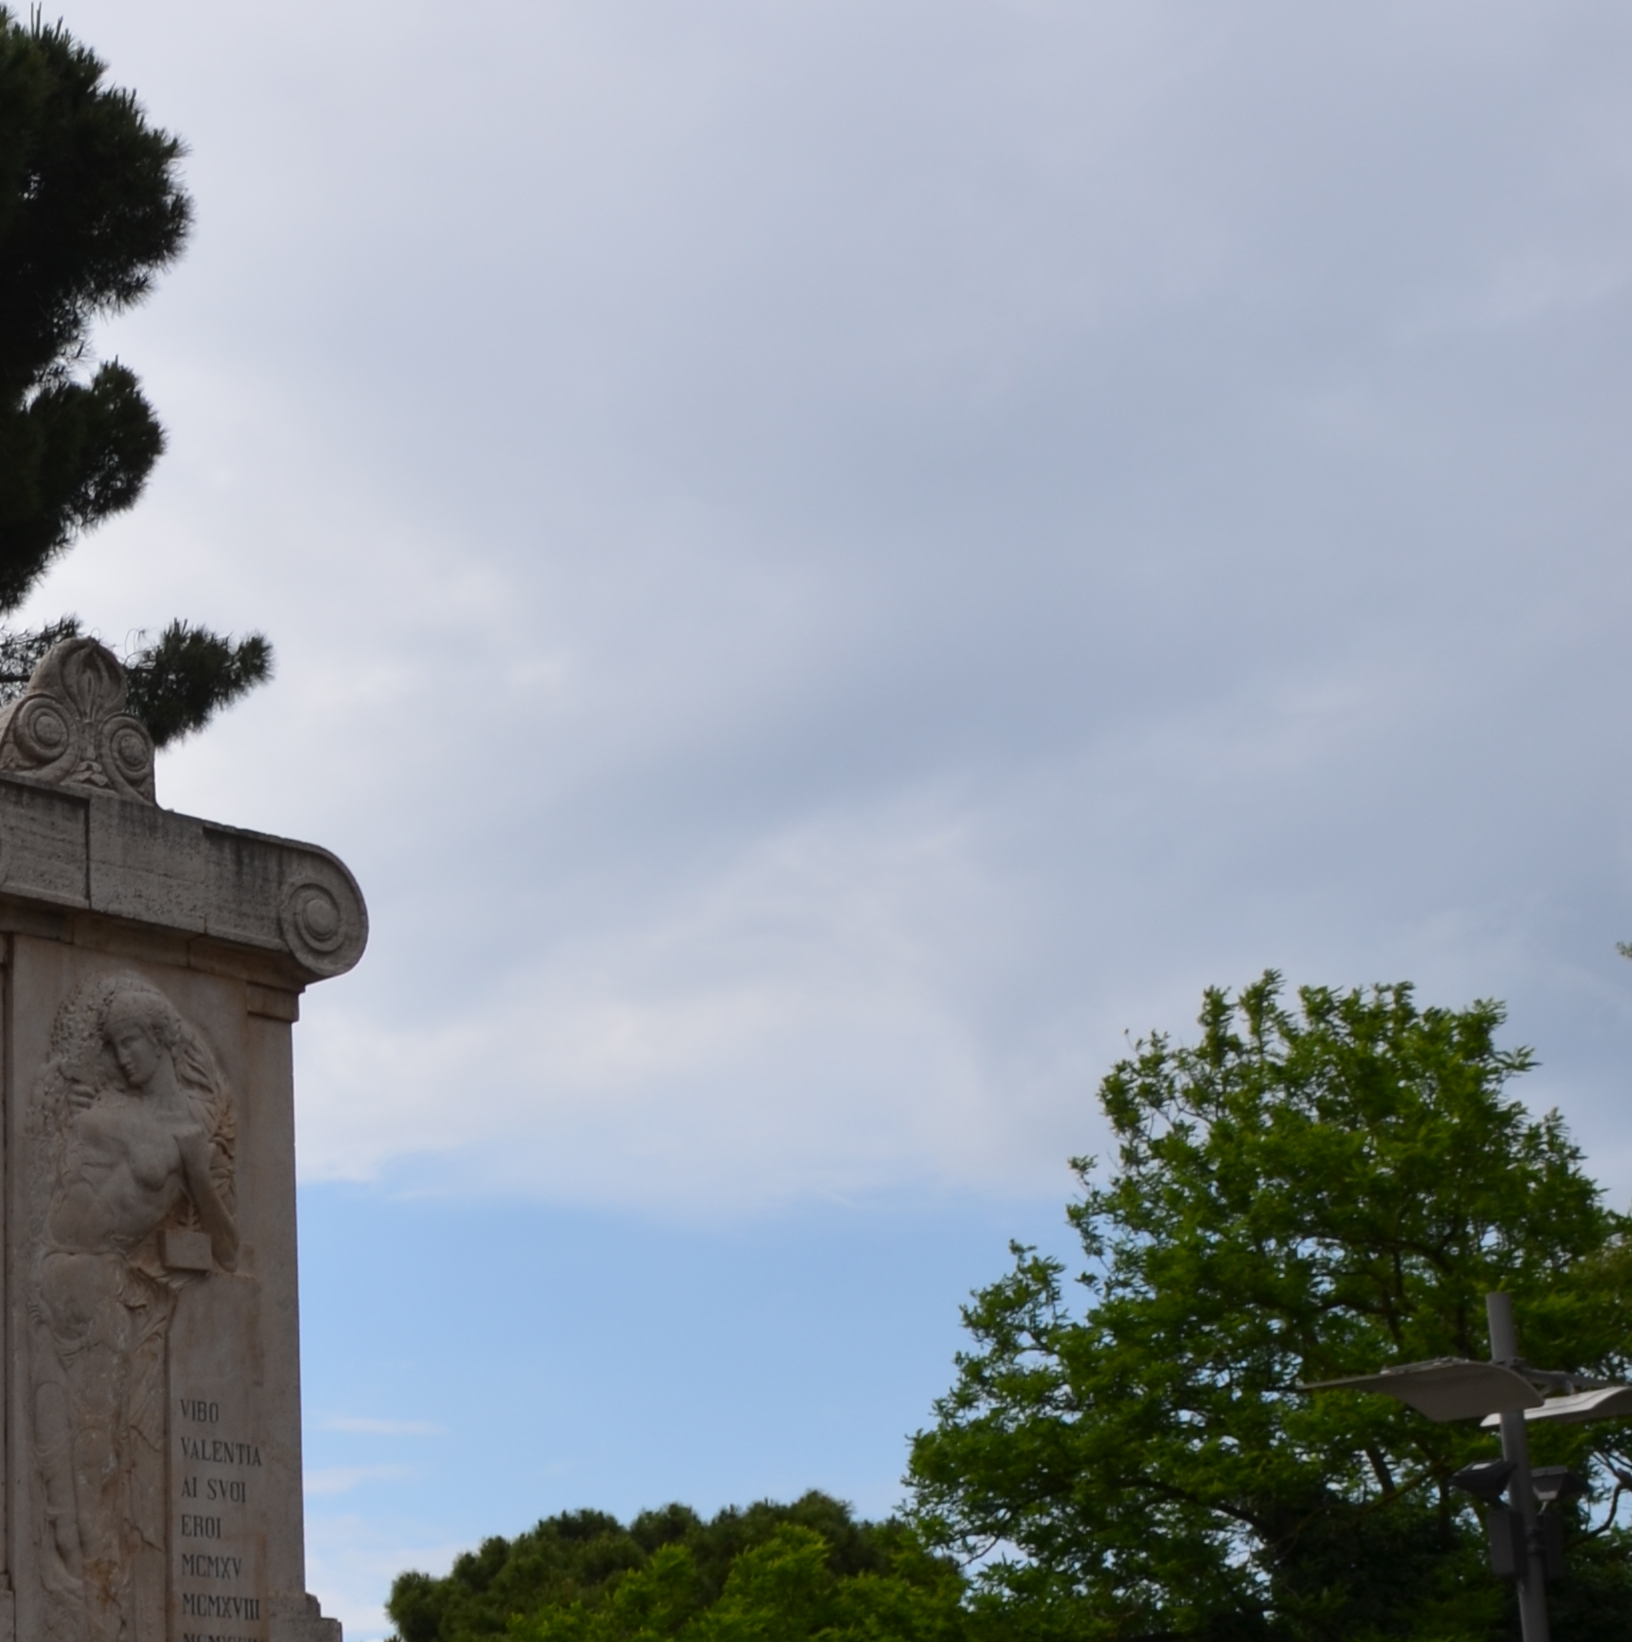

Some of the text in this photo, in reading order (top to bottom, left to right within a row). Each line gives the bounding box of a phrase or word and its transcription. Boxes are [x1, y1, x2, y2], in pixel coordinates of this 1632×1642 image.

[180, 1398, 219, 1424] VIBO
[180, 1437, 262, 1467] VALENTIA
[181, 1477, 246, 1503] AI SVOI
[181, 1515, 221, 1539] EROI
[181, 1554, 242, 1579] MCMXV
[181, 1593, 260, 1621] MCMXVIII
